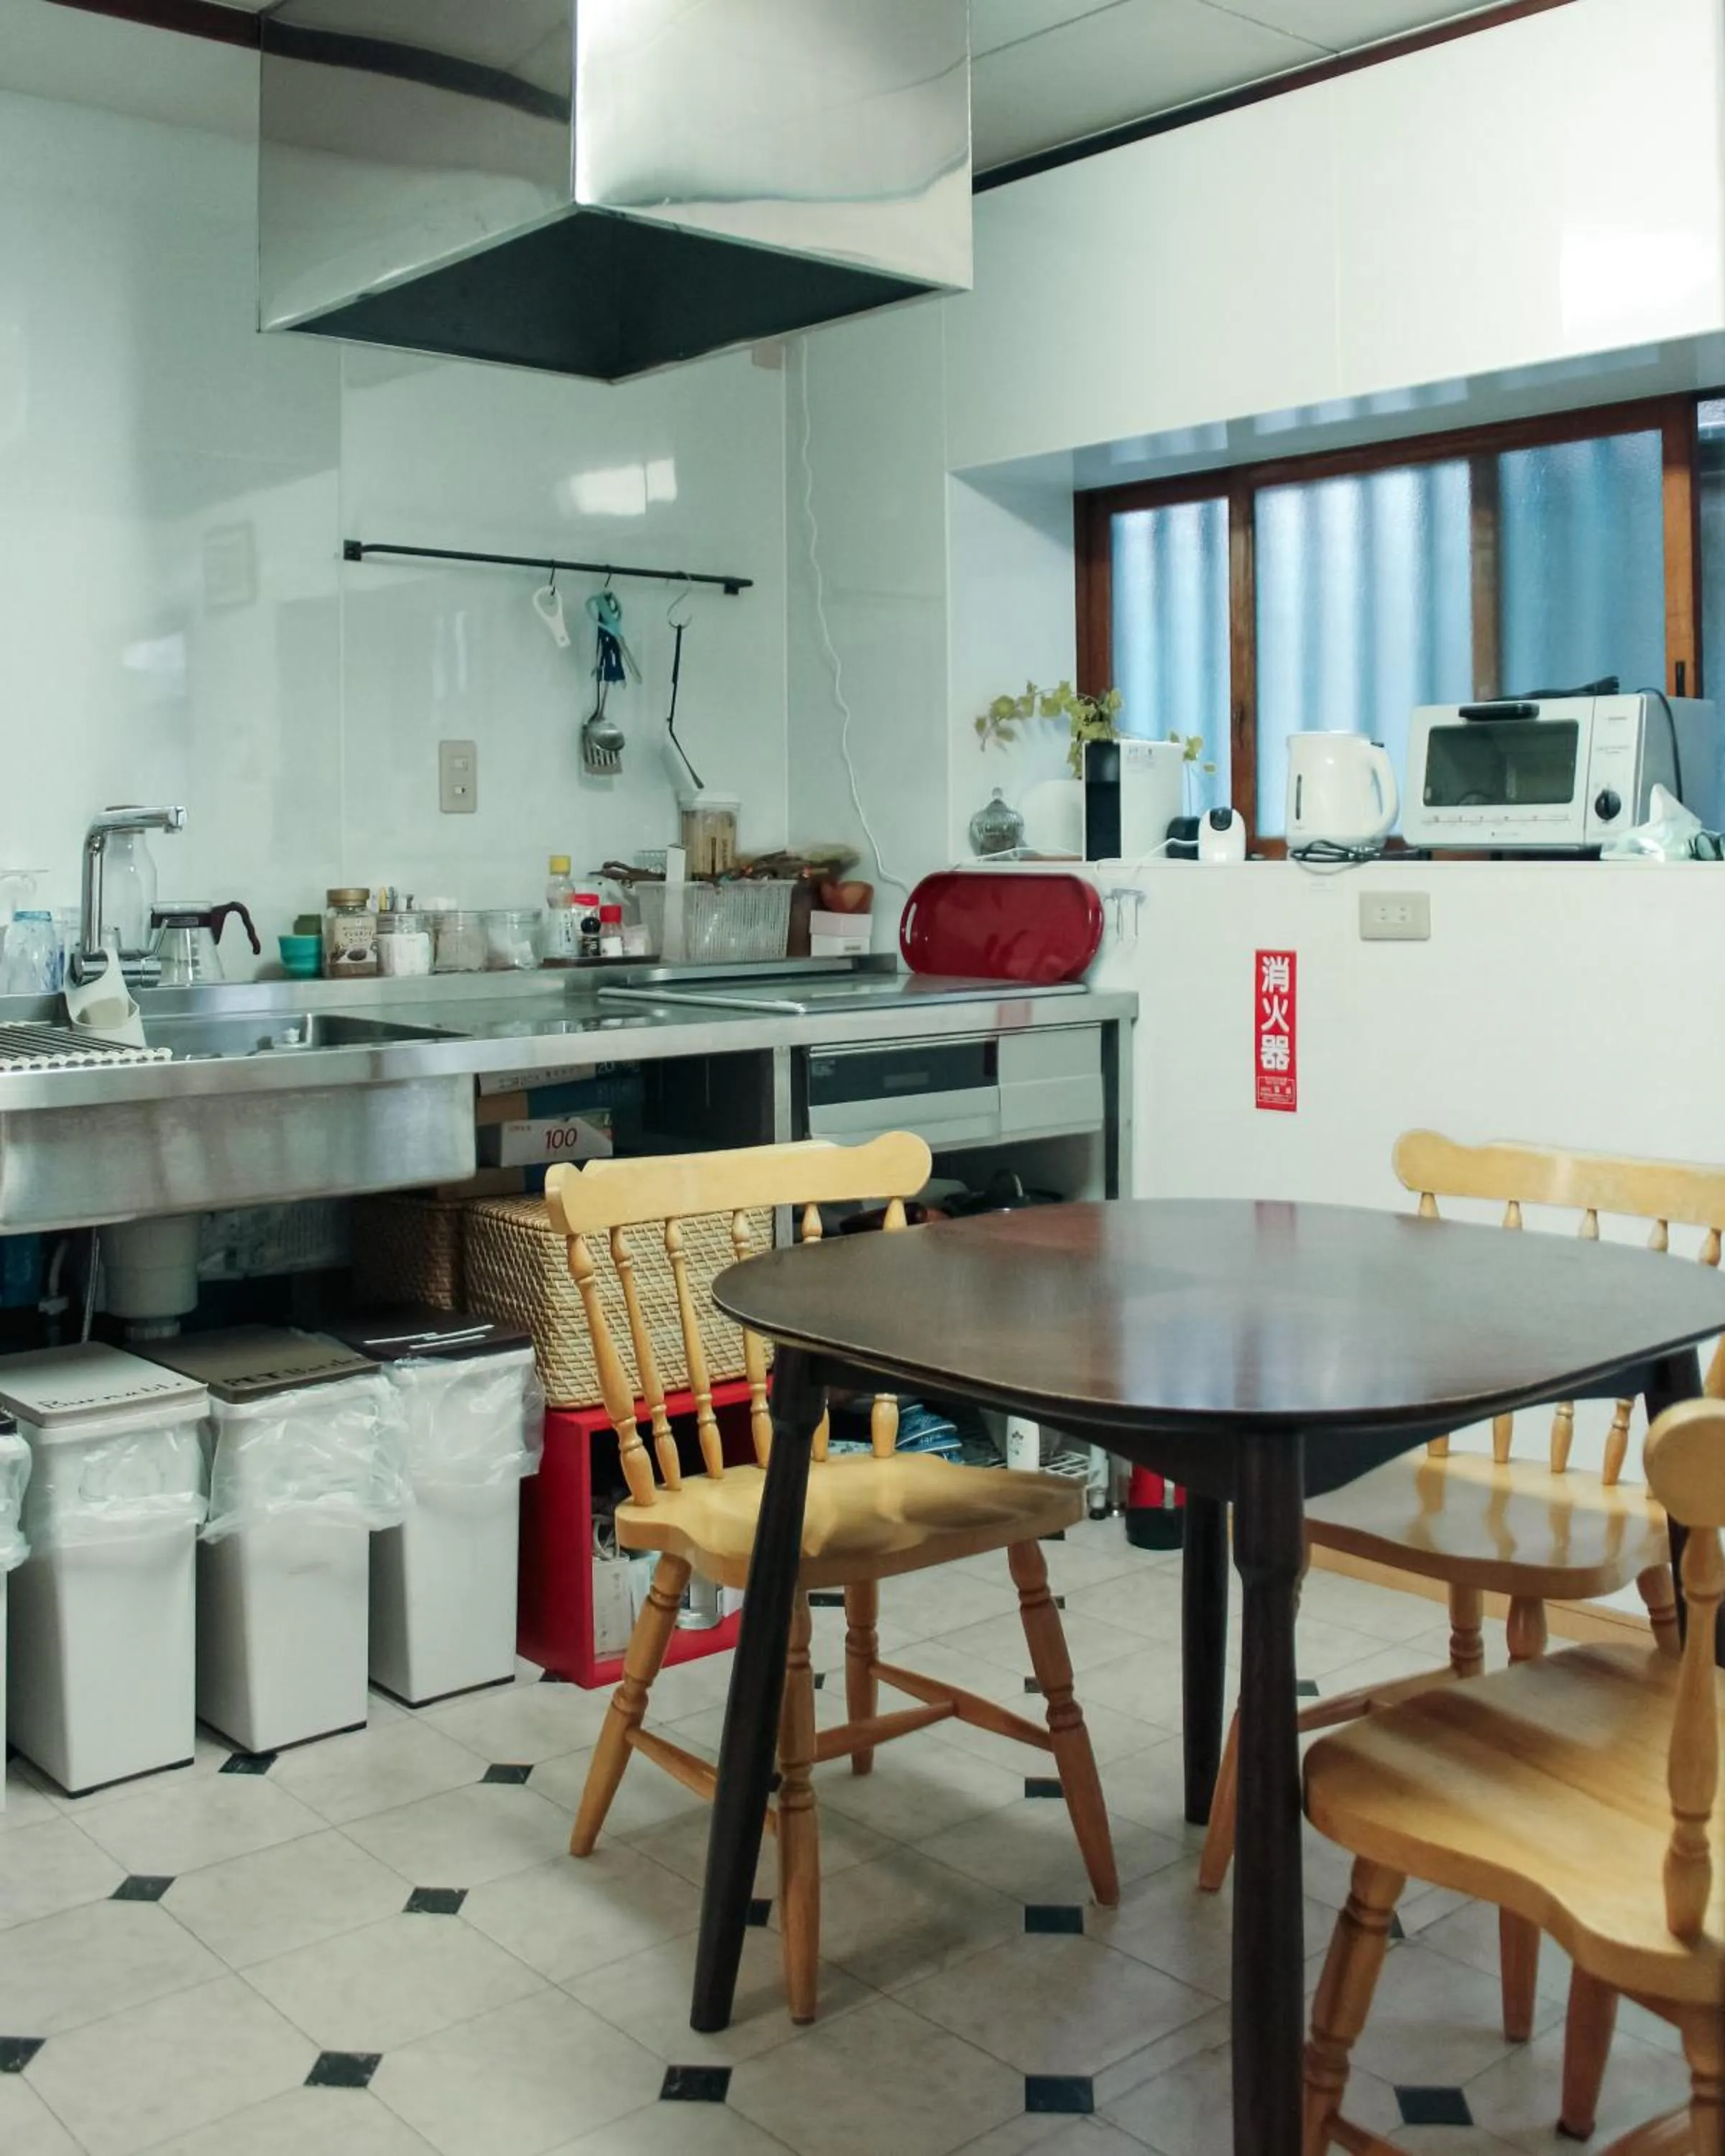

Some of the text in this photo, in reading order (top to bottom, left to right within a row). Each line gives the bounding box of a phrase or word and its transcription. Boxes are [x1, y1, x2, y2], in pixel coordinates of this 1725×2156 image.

[1261, 955, 1290, 1071] 消火器
[544, 1128, 578, 1151] 100
